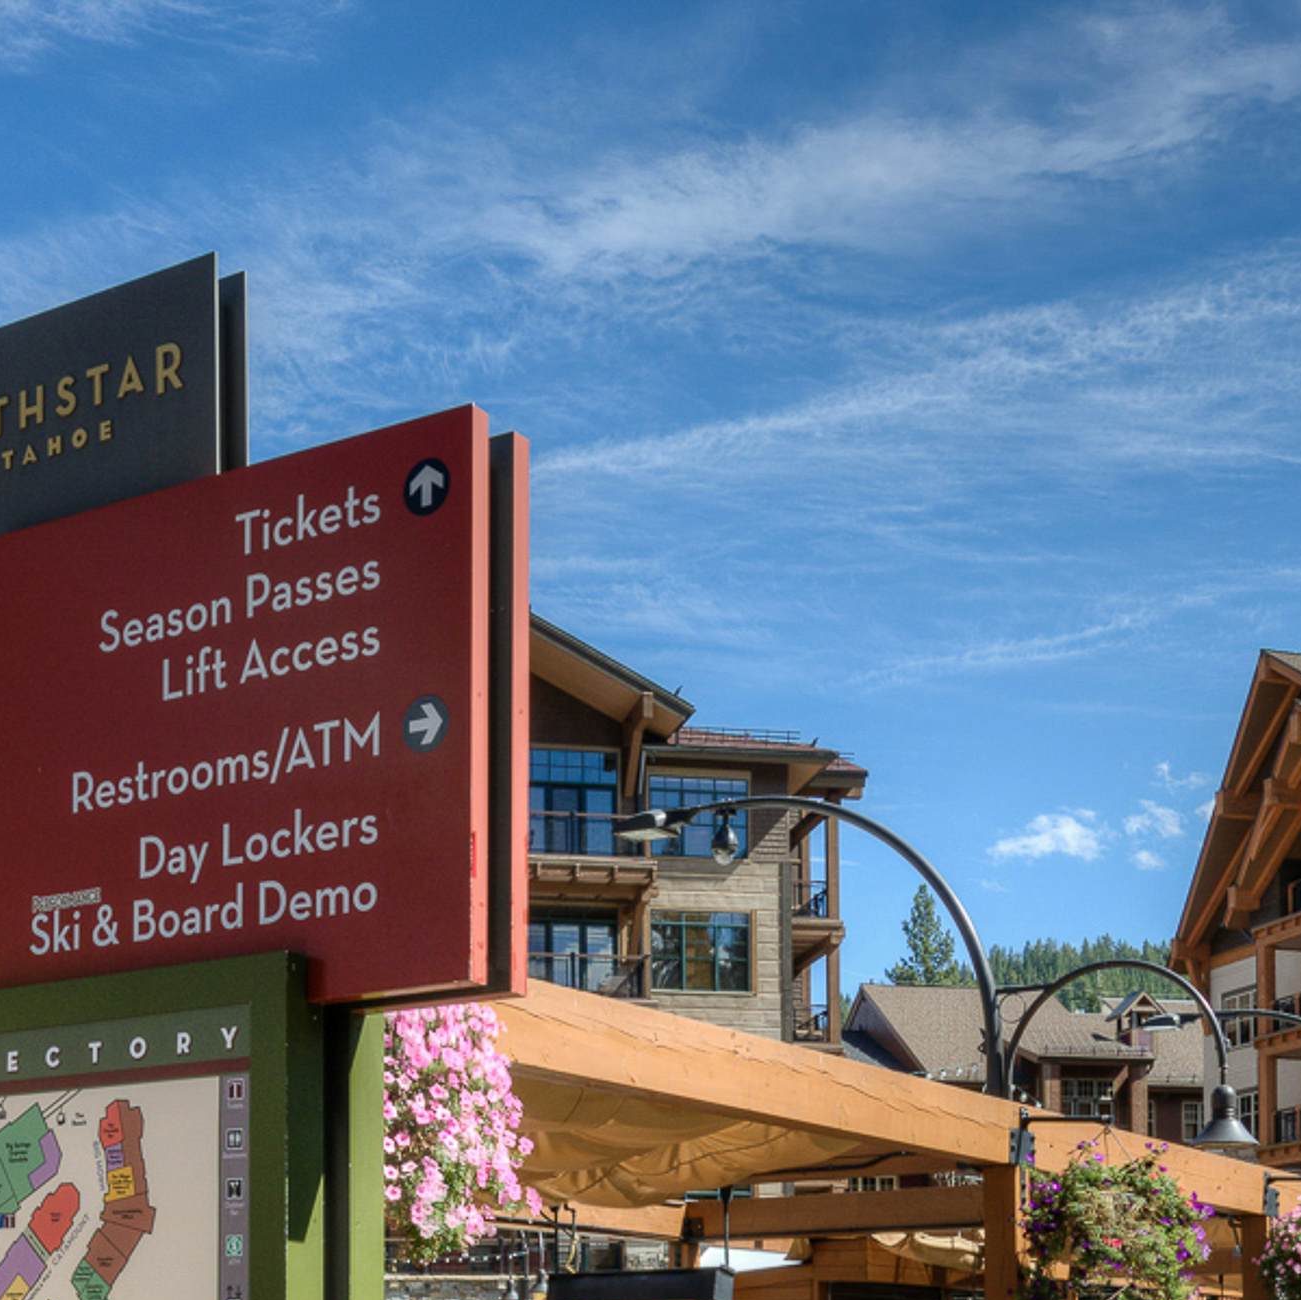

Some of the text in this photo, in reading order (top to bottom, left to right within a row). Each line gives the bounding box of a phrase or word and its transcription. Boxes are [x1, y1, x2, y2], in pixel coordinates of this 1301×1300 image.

[0, 420, 114, 473] TAHOE
[236, 485, 381, 556] Tickets
[99, 559, 381, 653] Season Passes
[161, 626, 381, 703] Lift Access
[71, 712, 381, 813] Restrooms/ATM
[138, 810, 379, 881] Day Lockers
[29, 876, 379, 956] Ski & Board Demo
